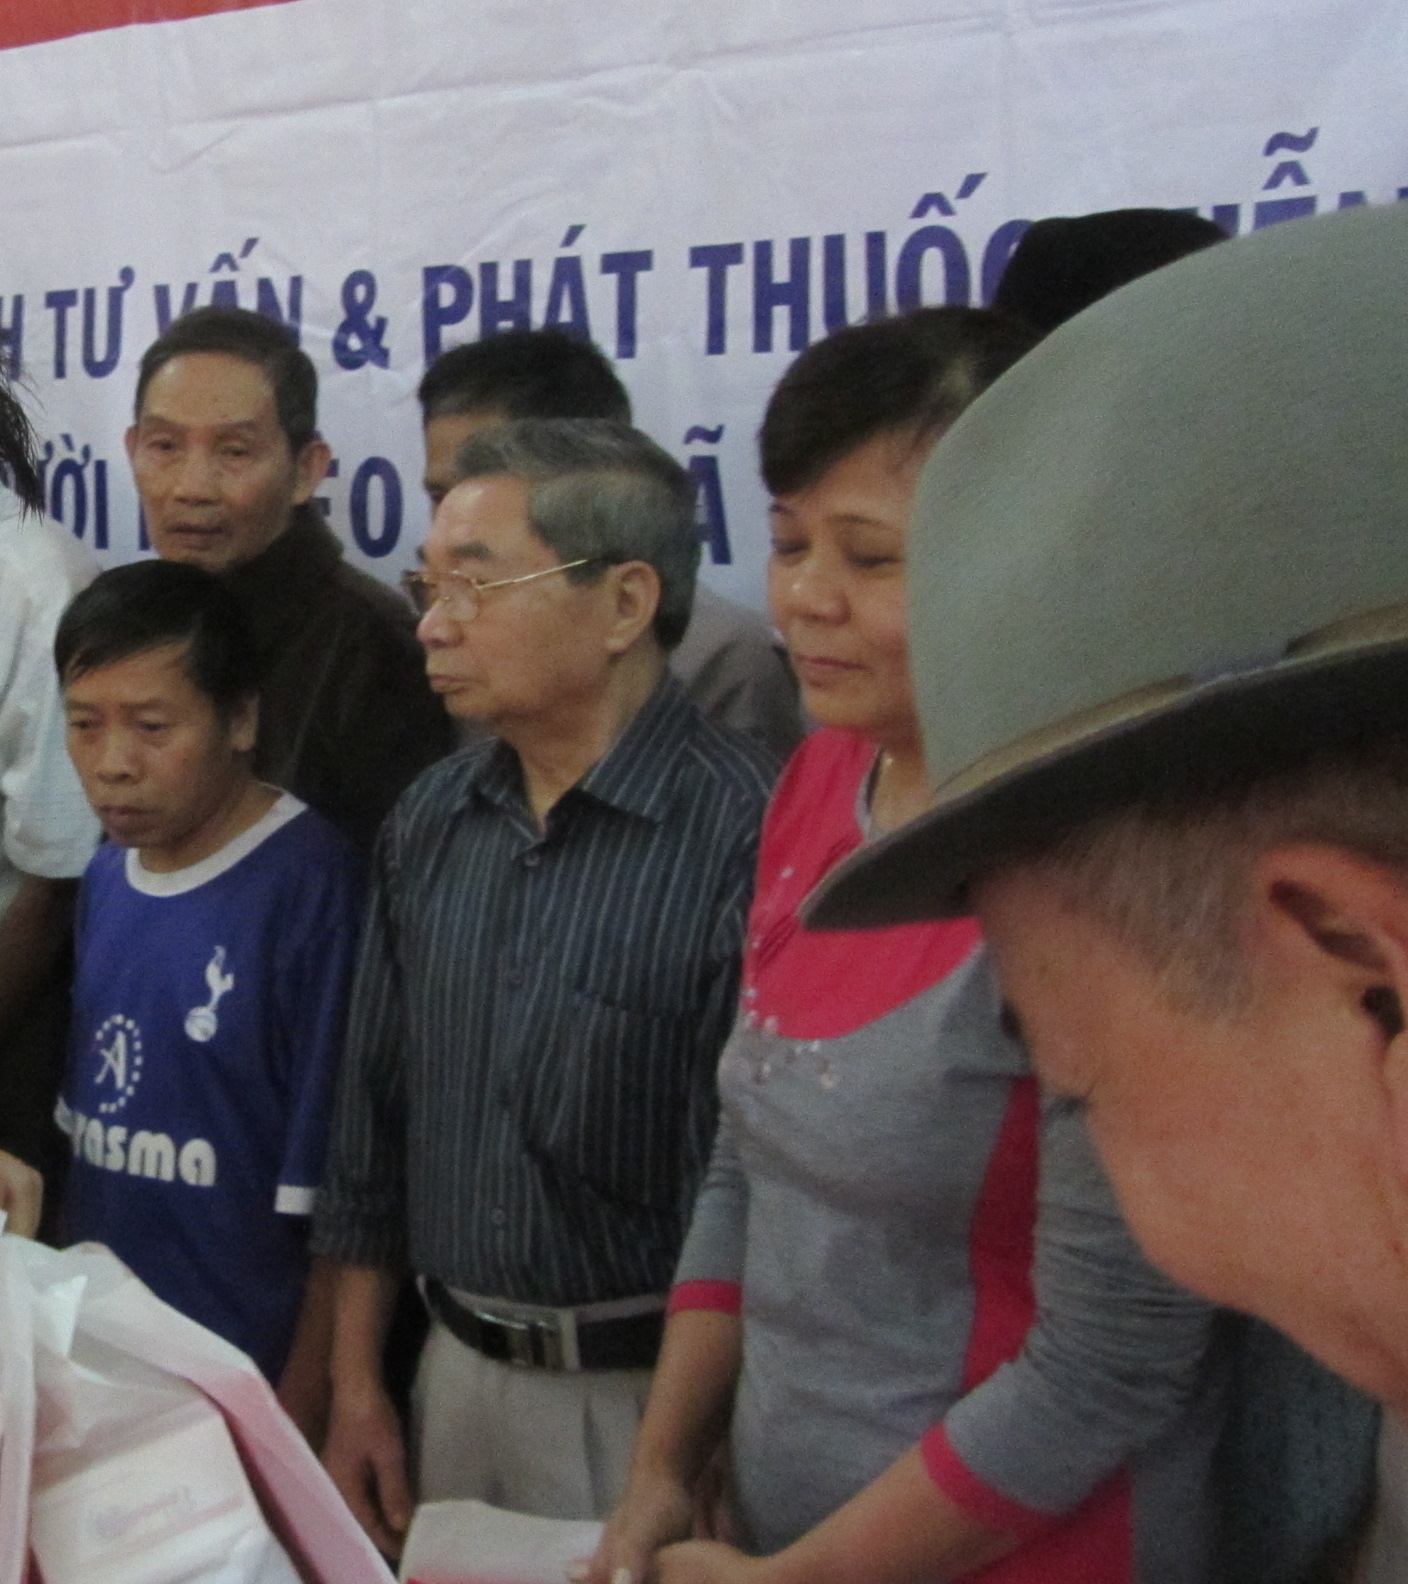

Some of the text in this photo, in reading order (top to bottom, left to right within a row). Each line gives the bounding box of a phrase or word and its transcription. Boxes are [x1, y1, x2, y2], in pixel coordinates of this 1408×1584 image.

[45, 266, 135, 380] TƯ
[332, 269, 390, 371] &
[422, 223, 654, 368] PHÁT
